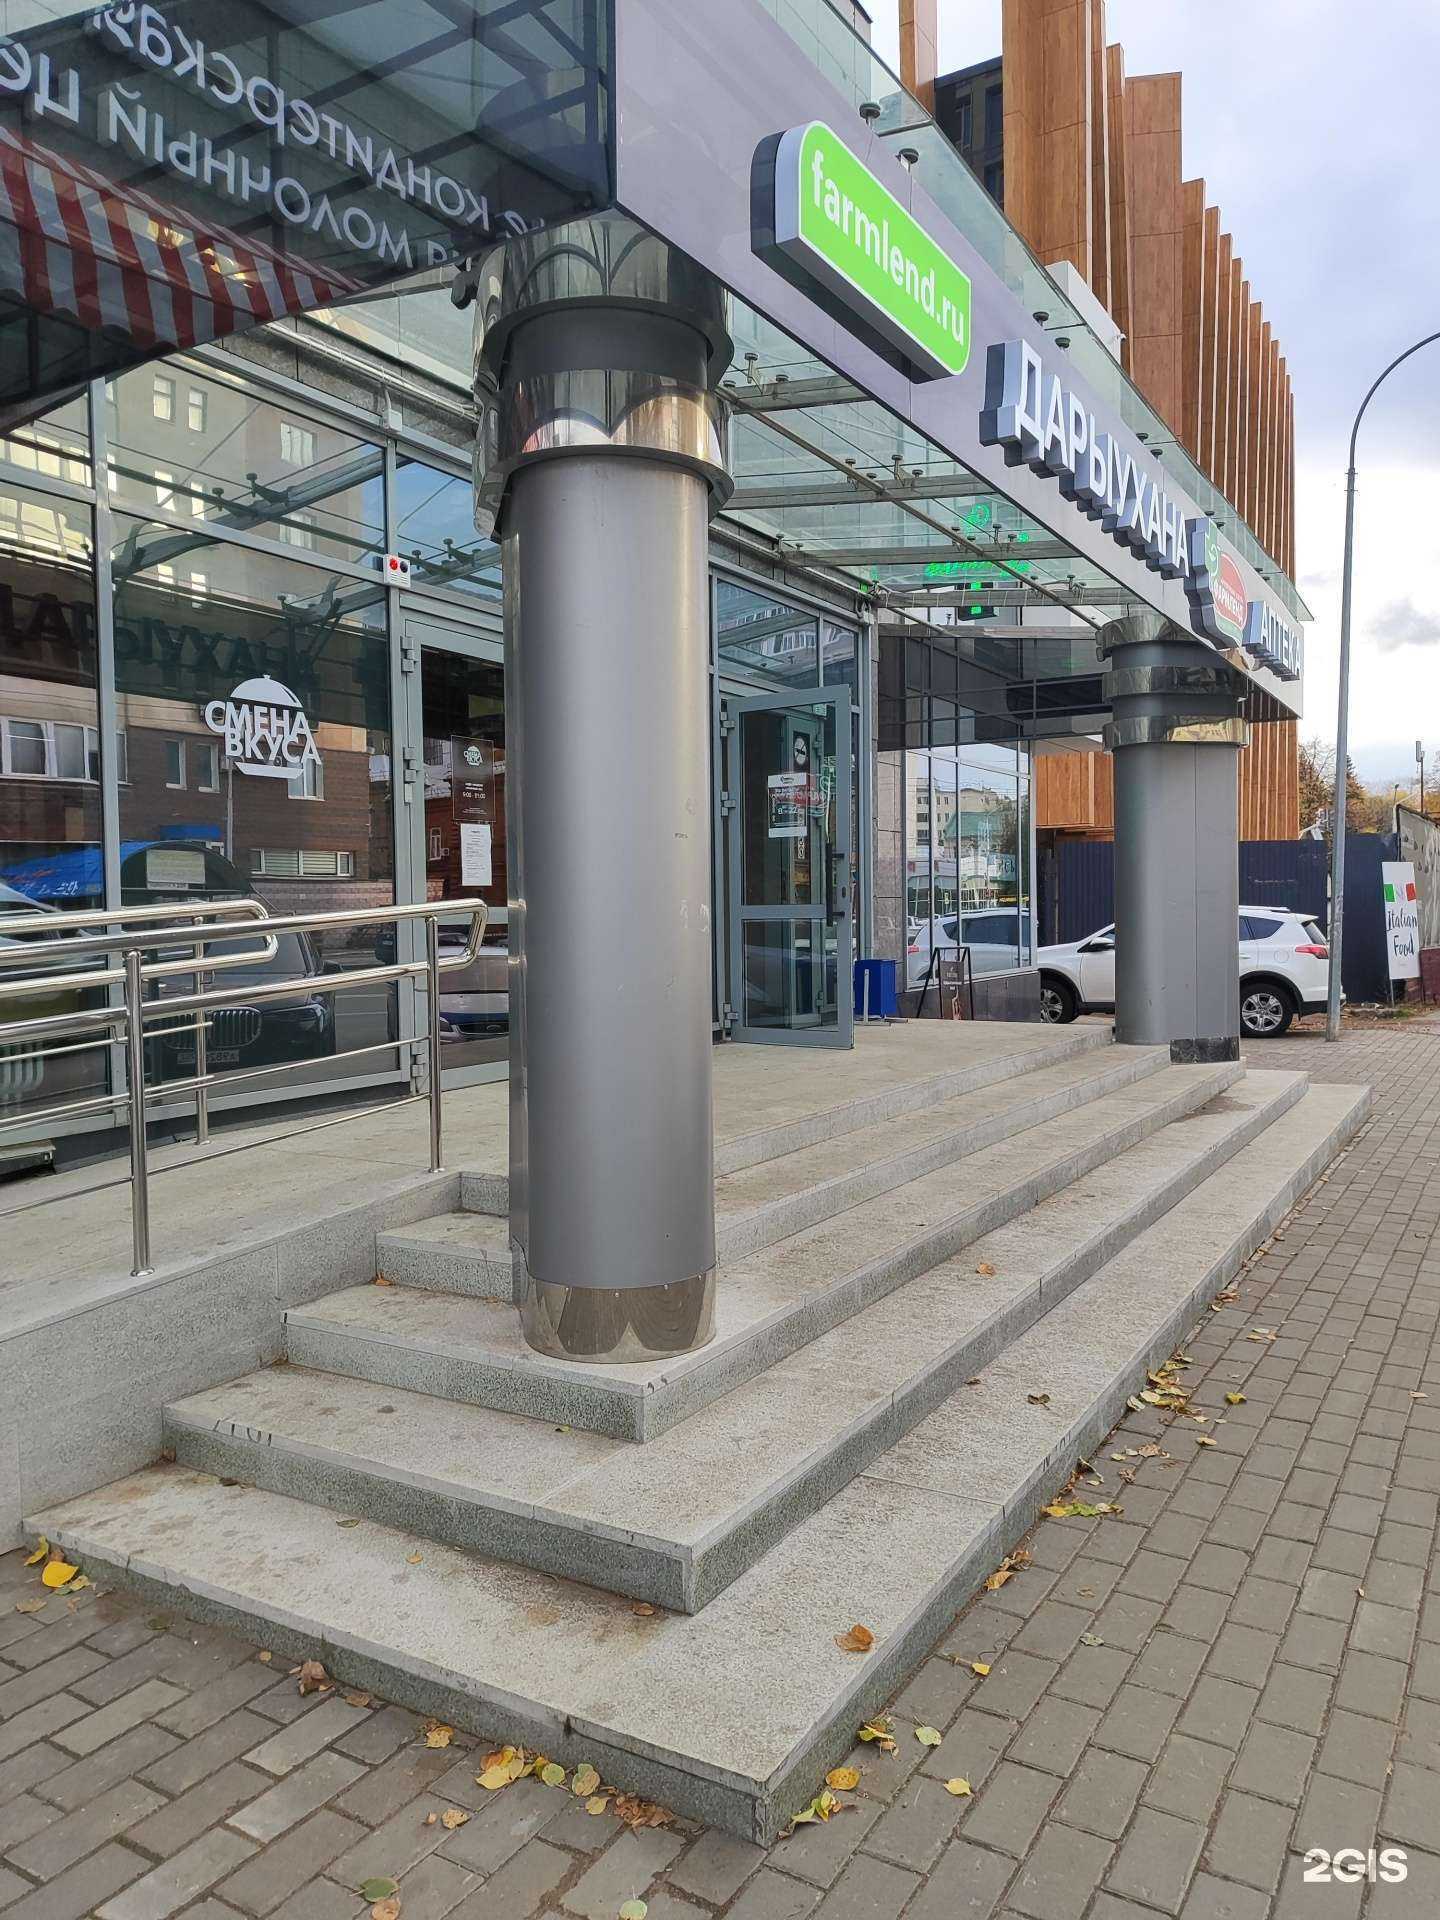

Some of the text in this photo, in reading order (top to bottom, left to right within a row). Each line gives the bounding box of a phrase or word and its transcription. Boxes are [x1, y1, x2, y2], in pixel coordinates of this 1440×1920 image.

[812, 150, 964, 346] farmlend.ru
[1014, 339, 1190, 577] ДАРЫУХАНА
[1261, 600, 1301, 677] АПТЕКА
[205, 701, 309, 738] СМЕНА
[225, 728, 322, 765] ВКУСА
[1386, 908, 1418, 931] Italian
[1394, 933, 1415, 956] Food
